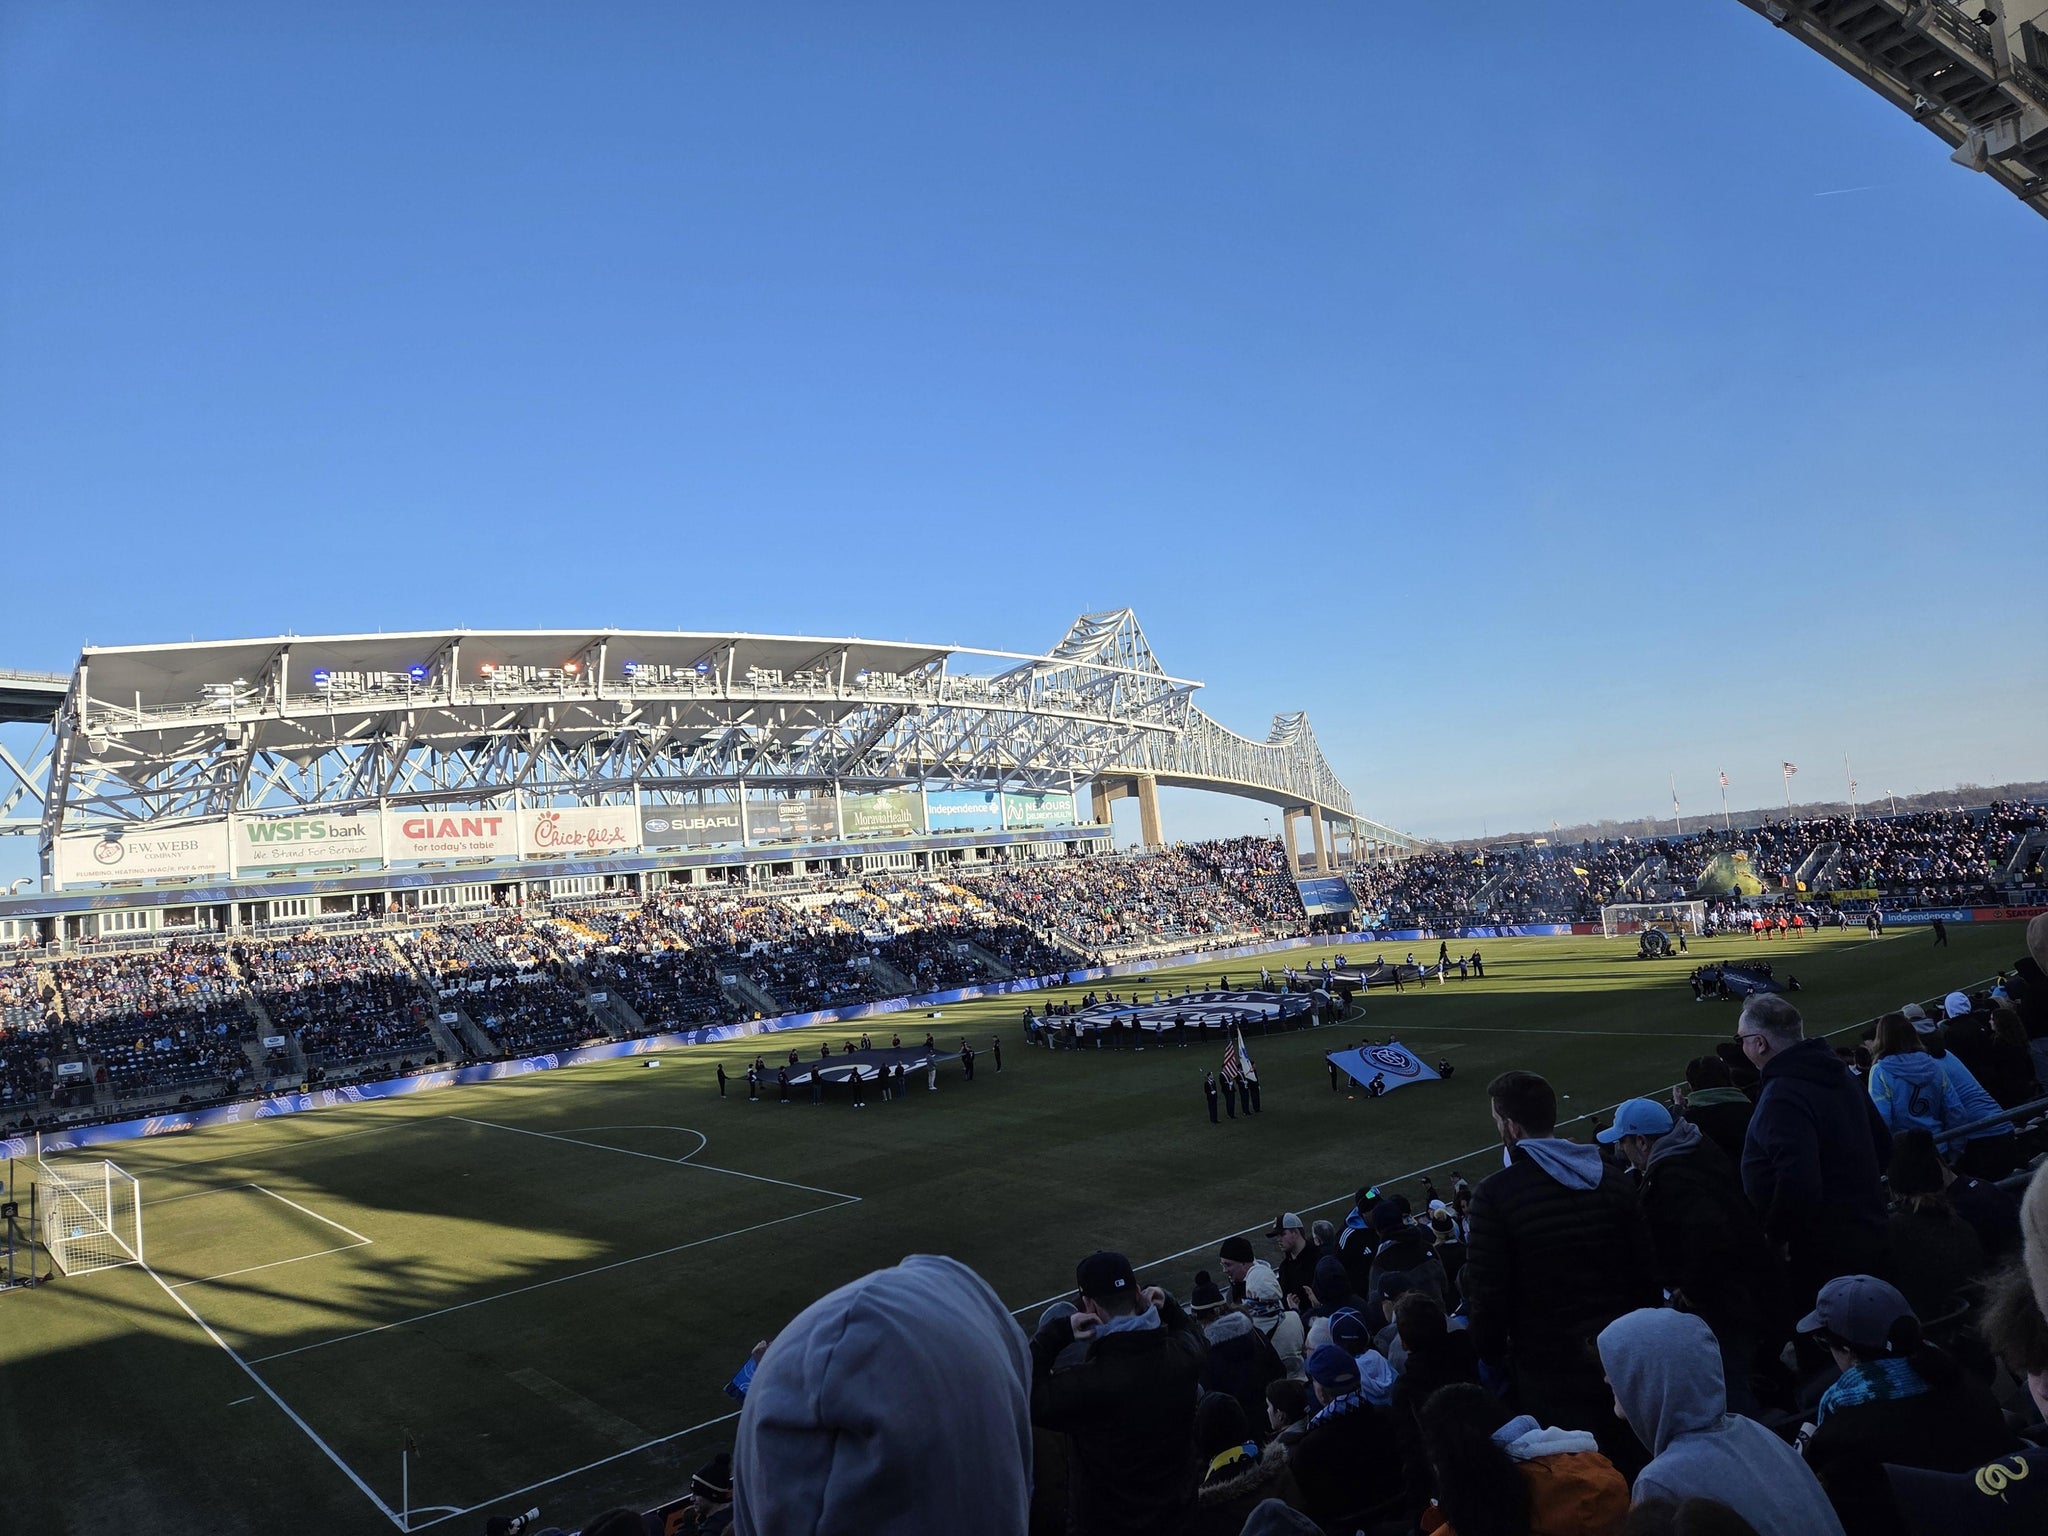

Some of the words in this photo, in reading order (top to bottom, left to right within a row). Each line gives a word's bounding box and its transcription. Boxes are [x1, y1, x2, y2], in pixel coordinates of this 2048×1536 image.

[780, 806, 804, 814] BIMBO
[929, 804, 988, 816] Independence
[402, 817, 502, 839] GIANT
[671, 816, 740, 830] SUBARU
[246, 820, 326, 842] WSFS
[329, 824, 366, 838] bank
[534, 814, 626, 848] Chick-fil-A
[157, 840, 199, 851] WEBB
[414, 844, 428, 852] for
[430, 842, 467, 852] today's
[470, 841, 494, 850] table
[144, 852, 184, 860] COMPANY
[254, 850, 267, 860] We
[272, 848, 304, 858] Stand
[308, 848, 326, 857] For
[1888, 912, 1950, 922] Independence
[1909, 1084, 1930, 1117] 6
[140, 1118, 194, 1136] Union
